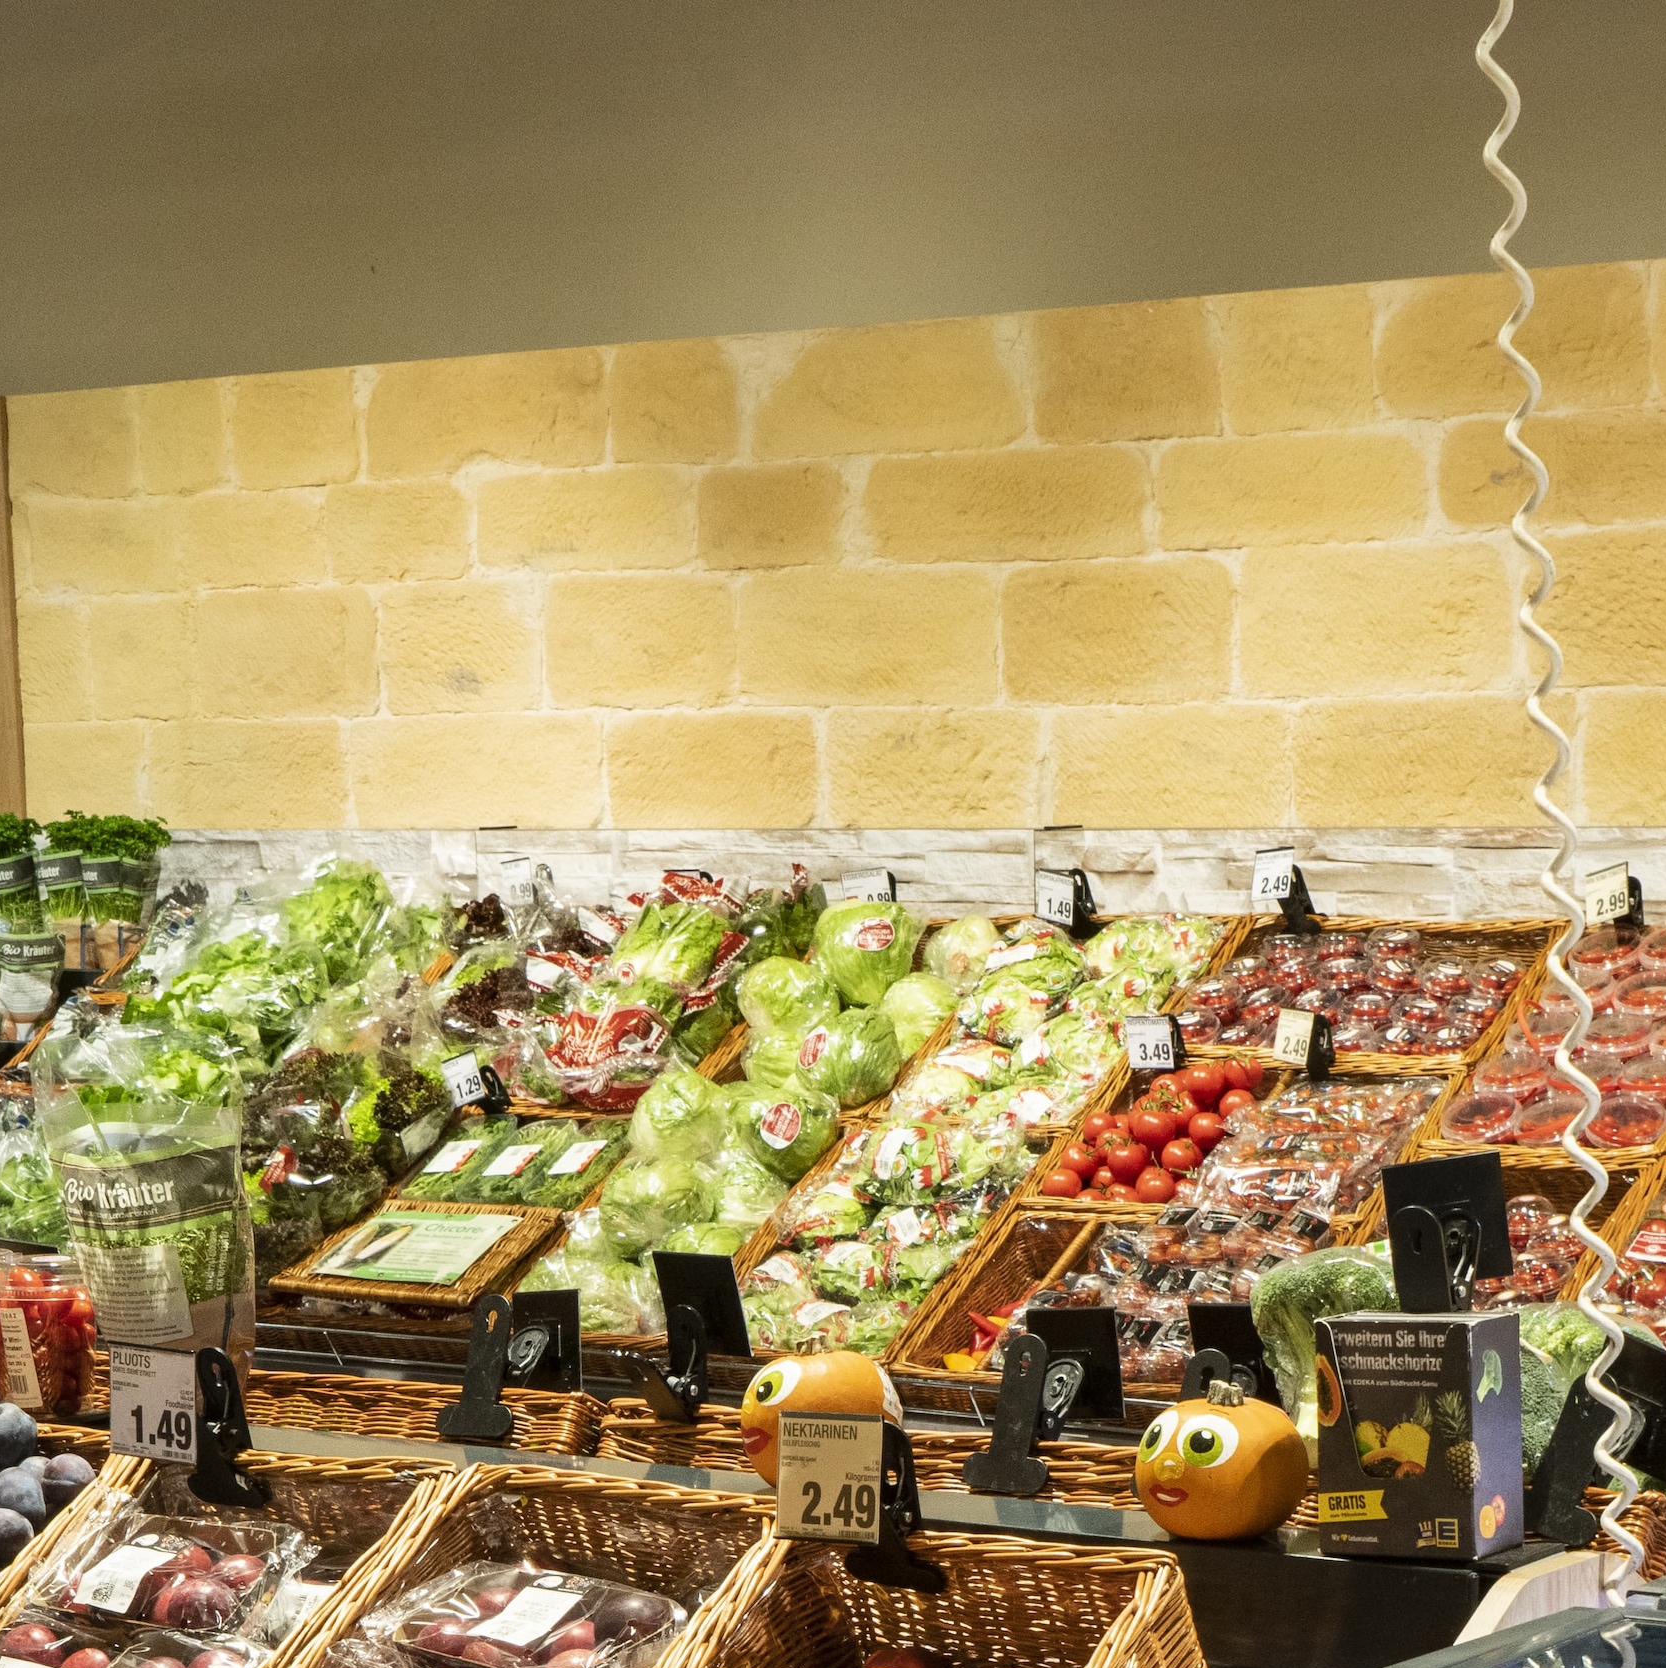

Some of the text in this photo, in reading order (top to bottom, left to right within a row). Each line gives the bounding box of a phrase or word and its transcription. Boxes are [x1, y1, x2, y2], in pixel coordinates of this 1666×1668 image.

[1260, 873, 1288, 894] 2.49
[1046, 898, 1072, 918] 1.49
[1596, 891, 1627, 917] 2.99
[23, 942, 56, 959] Kräuter
[1136, 1041, 1170, 1063] 3.49
[1282, 1035, 1308, 1057] 2.49
[456, 1074, 482, 1099] 1.29
[65, 1177, 175, 1209] Bio Kräuter
[1395, 1330, 1417, 1350] Sie
[1420, 1330, 1446, 1351] Ihre
[112, 1352, 152, 1370] PLUOTS
[1351, 1378, 1439, 1389] EDEKA zum Südfrucht-Genu
[165, 1400, 195, 1412] Foodtainer
[130, 1405, 193, 1451] 1.49
[782, 1421, 859, 1444] NEKTARINEN
[845, 1471, 880, 1483] Kilogramm
[800, 1480, 878, 1530] 2.49
[1327, 1494, 1367, 1513] GRATIS
